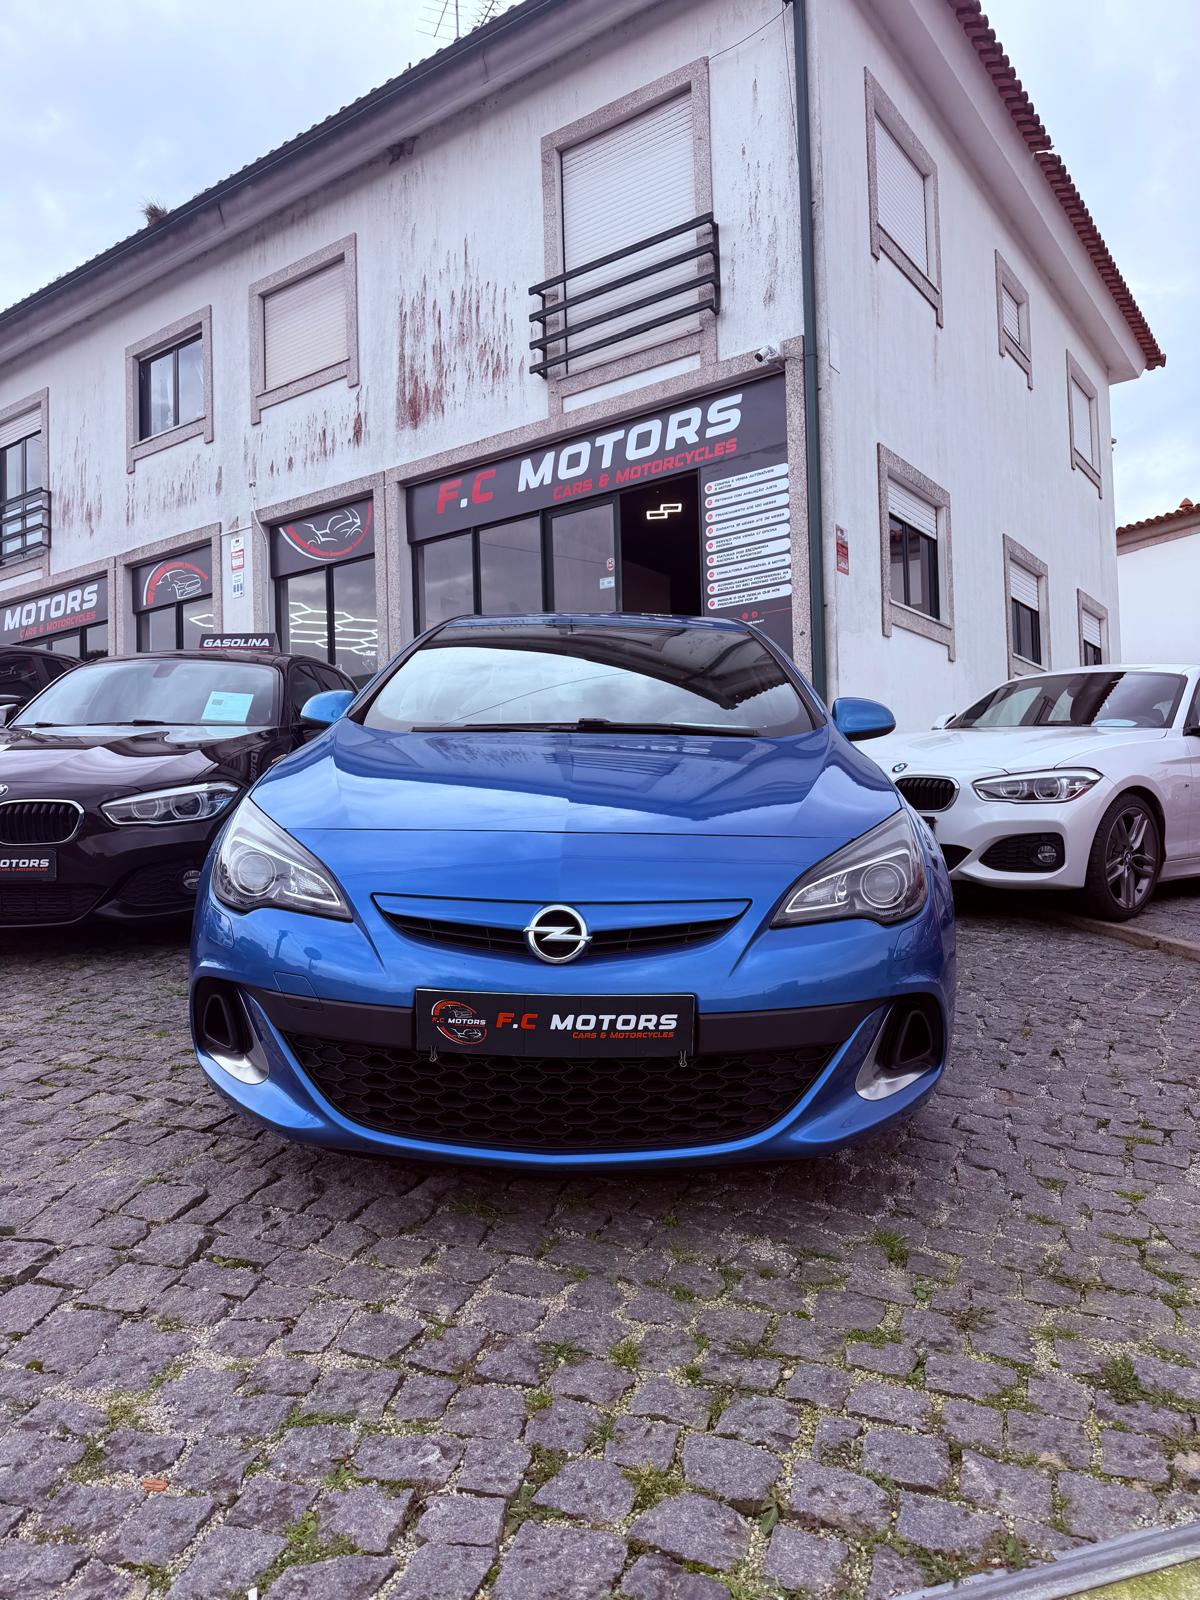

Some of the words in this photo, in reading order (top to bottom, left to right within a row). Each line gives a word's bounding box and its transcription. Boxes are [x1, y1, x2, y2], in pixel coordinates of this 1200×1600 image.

[437, 470, 496, 514] F.C
[518, 394, 743, 492] MOTORS
[552, 479, 592, 500] CARS
[598, 474, 609, 488] &
[615, 438, 737, 483] MOTORCYCLES
[4, 584, 98, 631] MOTORS
[20, 624, 37, 640] CARS
[46, 611, 96, 631] MOTORCYCLES
[203, 638, 269, 647] GASOLINA
[0, 859, 49, 868] OTORS
[496, 1012, 538, 1030] F.C
[550, 1014, 678, 1030] MOTORS
